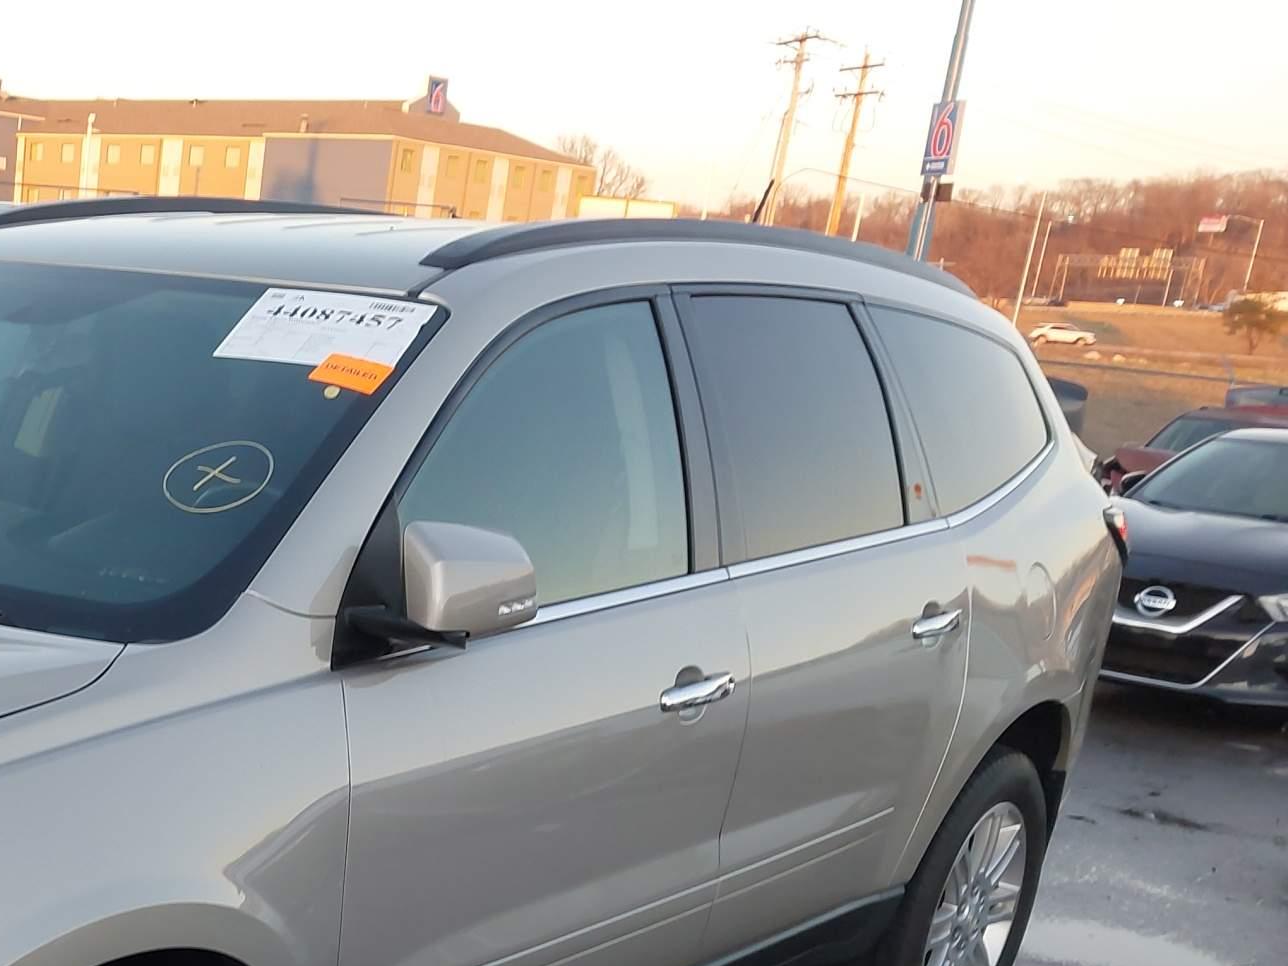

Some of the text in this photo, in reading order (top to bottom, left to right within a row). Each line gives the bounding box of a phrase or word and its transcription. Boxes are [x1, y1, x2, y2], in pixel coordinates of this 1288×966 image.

[931, 101, 954, 158] 6
[266, 302, 403, 330] 44087457
[325, 362, 378, 382] DETAILED
